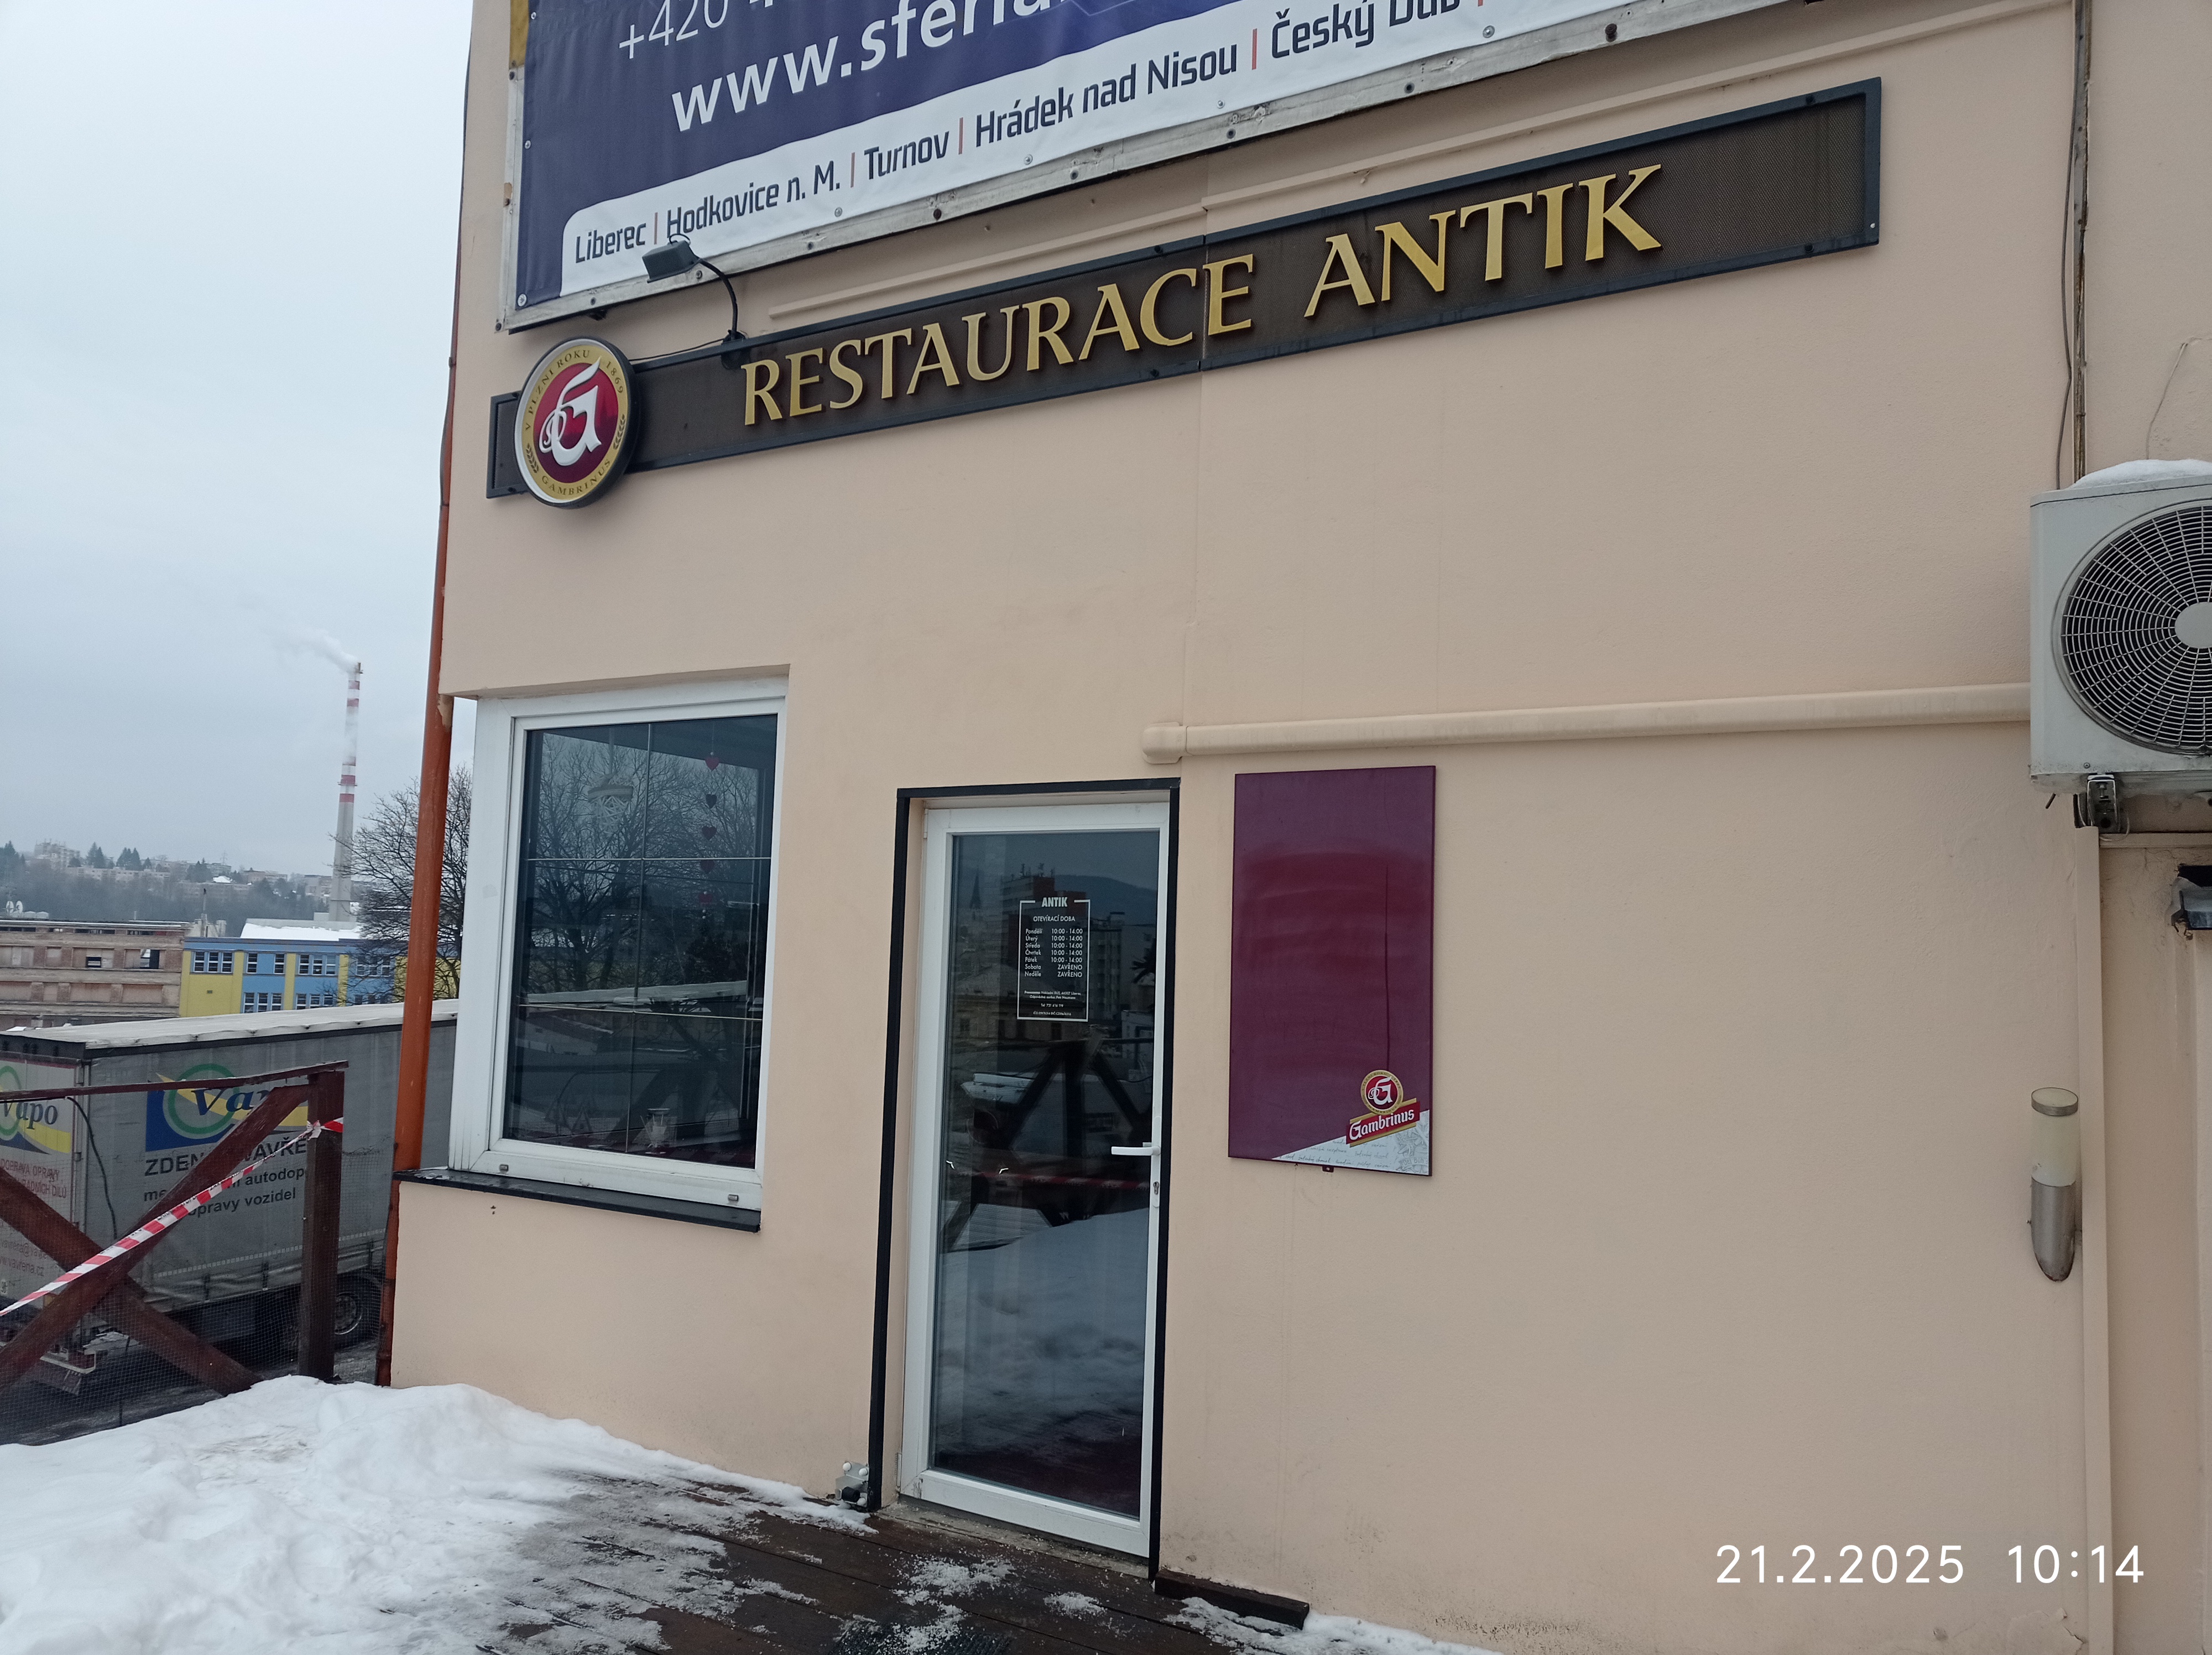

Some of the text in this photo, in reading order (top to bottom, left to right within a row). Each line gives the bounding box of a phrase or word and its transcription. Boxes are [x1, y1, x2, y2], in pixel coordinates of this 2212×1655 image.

[576, 219, 646, 263] Liberec
[667, 181, 779, 240] Hodkovice
[786, 177, 806, 203] n.
[813, 160, 841, 194] M.
[864, 131, 949, 180] Turnov
[975, 85, 1073, 147] Hrádek
[1082, 64, 1136, 113] nad
[1147, 44, 1237, 94] Nisou
[1272, 0, 1375, 59] Český
[740, 164, 1663, 426] RESTAURACE ANTIK
[556, 349, 590, 369] ROKU
[606, 361, 623, 394] 1869
[542, 459, 611, 496] GAMBRINUS
[1041, 897, 1068, 907] ANTIK
[1349, 1109, 1415, 1141] Gambrinus
[245, 1166, 304, 1187] autodop
[244, 1187, 296, 1206] vozidel
